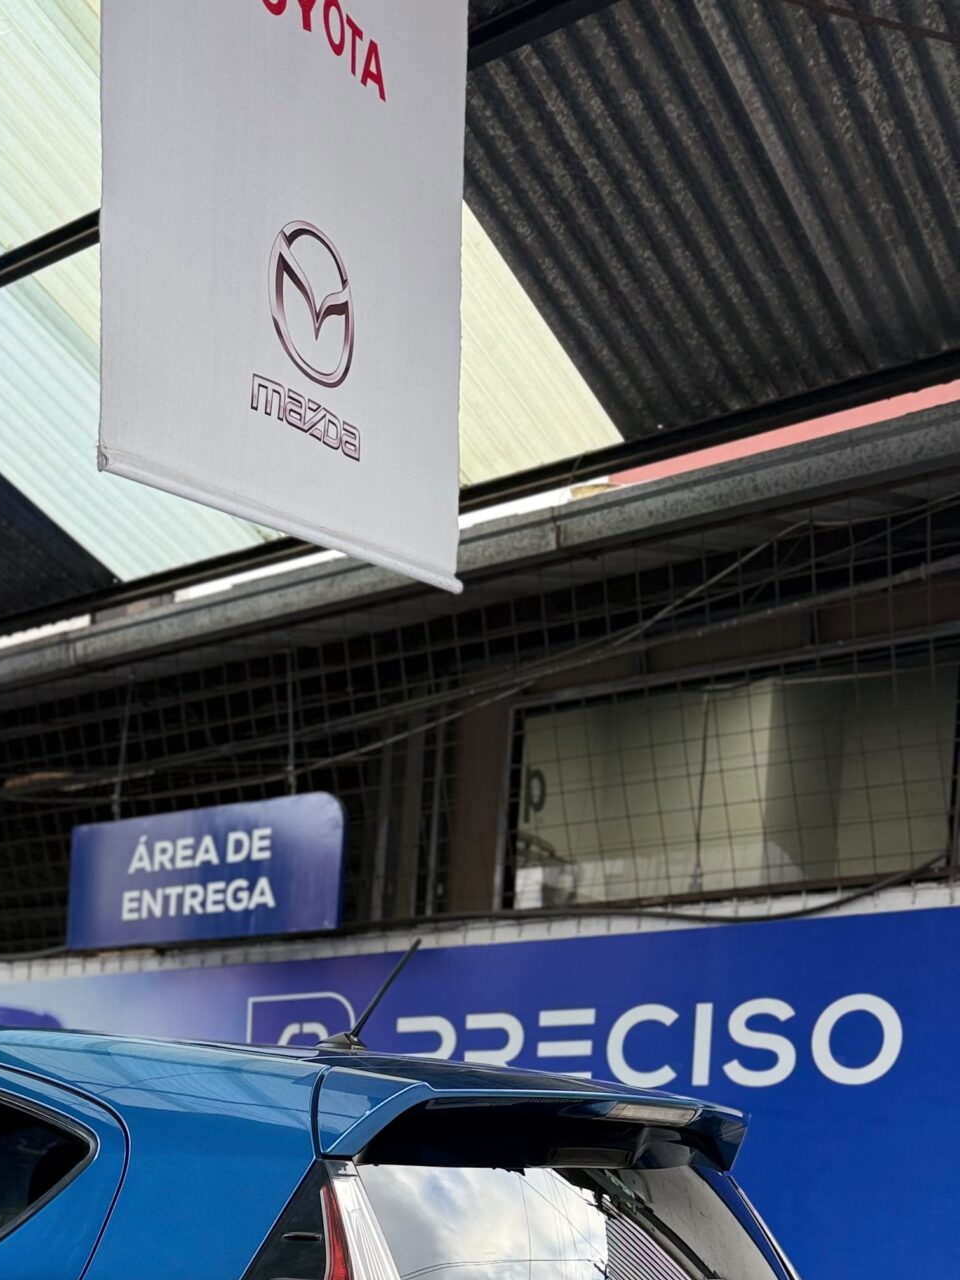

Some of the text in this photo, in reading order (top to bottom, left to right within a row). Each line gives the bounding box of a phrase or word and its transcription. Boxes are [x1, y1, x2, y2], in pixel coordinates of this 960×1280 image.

[128, 827, 272, 874] ÁREA DE
[121, 876, 276, 921] ENTREGA
